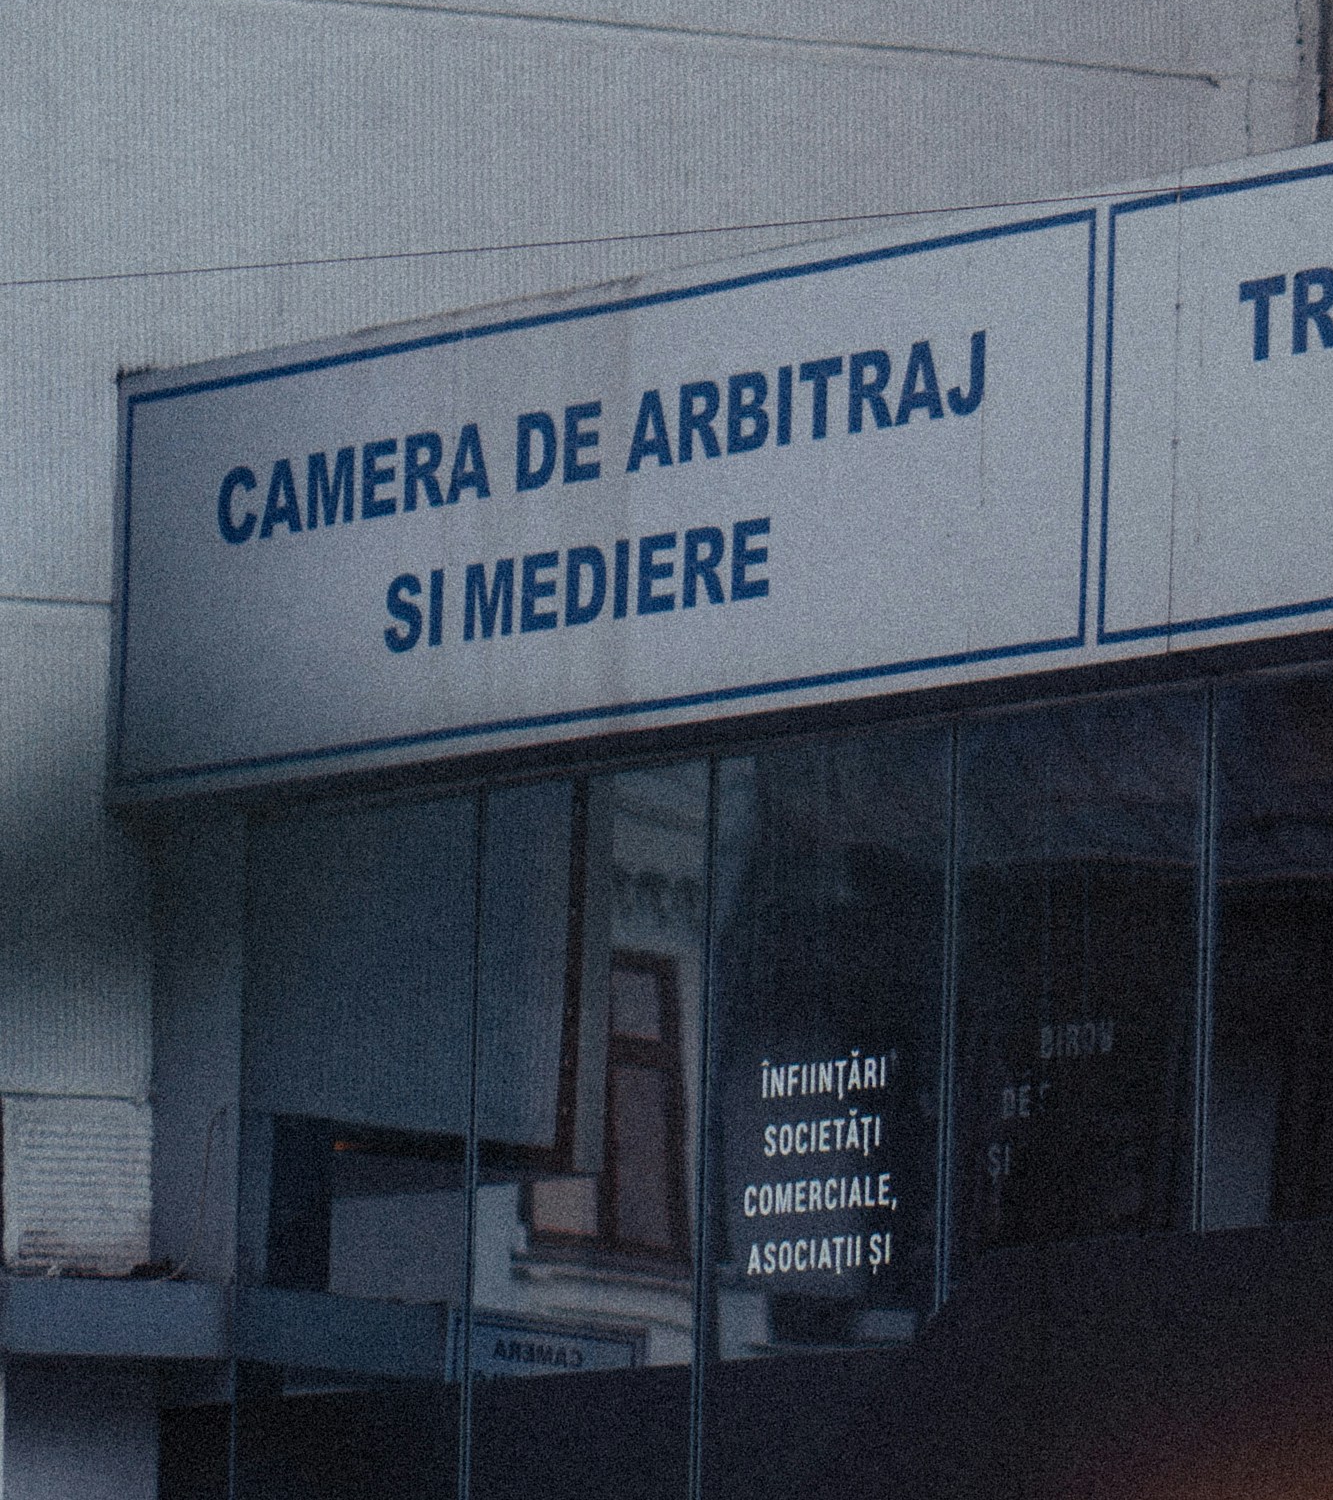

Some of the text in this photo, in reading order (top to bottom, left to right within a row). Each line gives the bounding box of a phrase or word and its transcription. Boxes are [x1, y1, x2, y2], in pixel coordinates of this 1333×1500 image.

[214, 330, 987, 548] CAMERA DE ARBITRAJ
[383, 516, 772, 655] SI MEDIERE
[743, 1172, 898, 1218] COMERCIALE,
